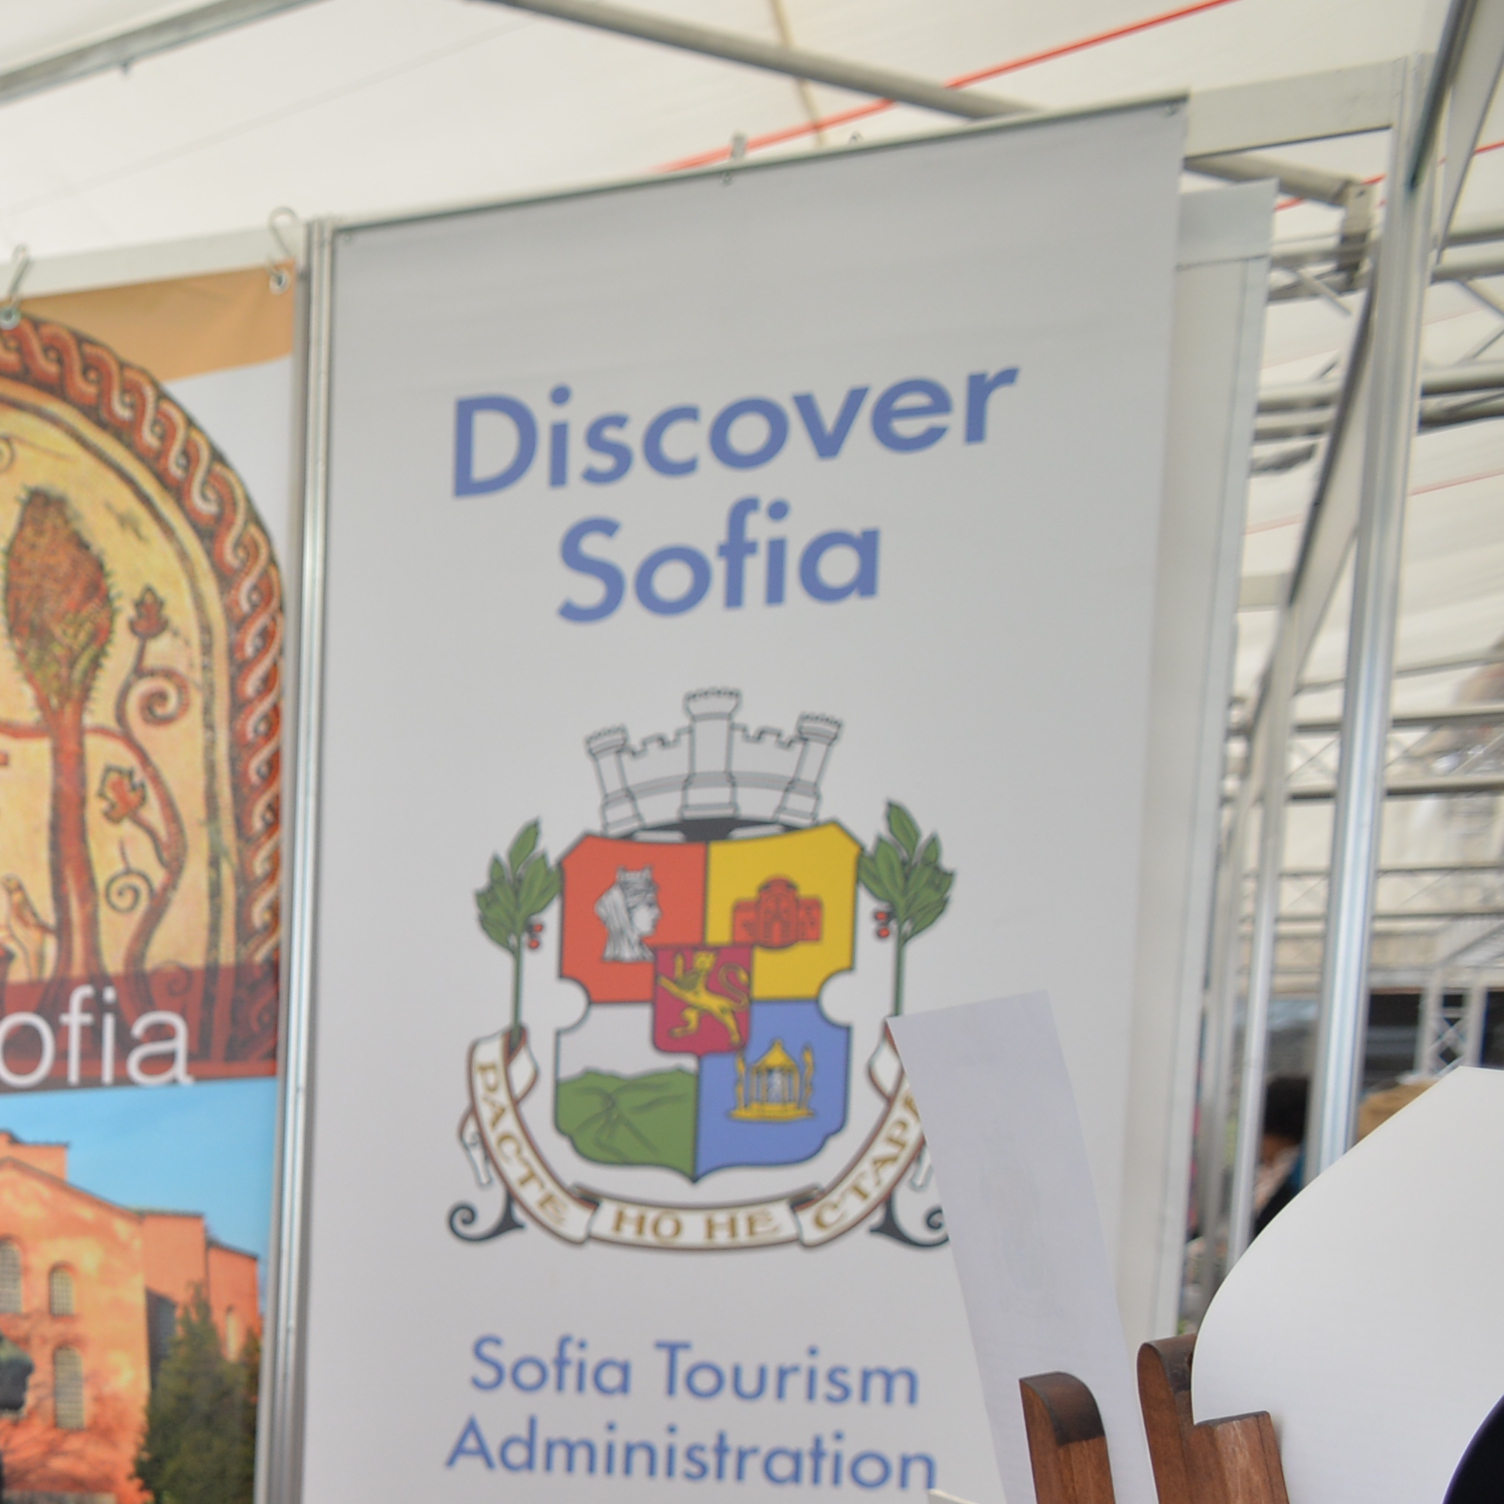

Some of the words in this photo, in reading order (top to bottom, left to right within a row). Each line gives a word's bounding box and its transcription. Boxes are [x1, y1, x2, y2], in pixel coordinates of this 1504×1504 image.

[454, 366, 1020, 497] Discover
[557, 496, 880, 624] Sofia
[470, 1334, 632, 1396] Sofia
[654, 1340, 919, 1407] Tourism
[445, 1414, 937, 1490] Administration
